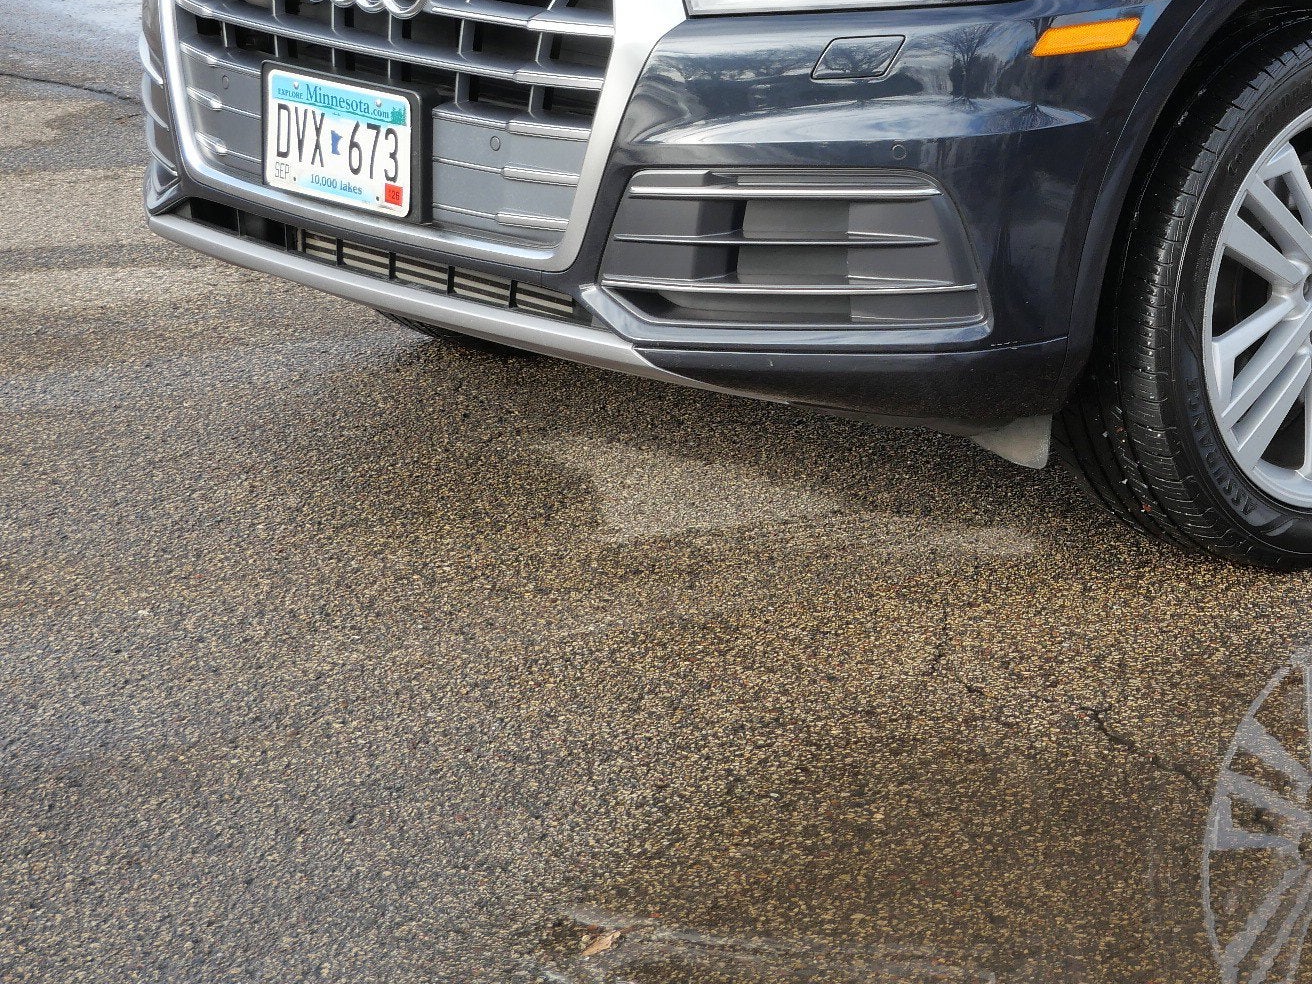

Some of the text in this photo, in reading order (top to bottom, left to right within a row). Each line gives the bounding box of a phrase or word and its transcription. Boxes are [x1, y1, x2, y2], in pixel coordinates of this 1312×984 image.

[277, 88, 304, 100] EXPLORE
[276, 103, 399, 183] DVX 673
[274, 161, 290, 179] SEP
[310, 173, 363, 195] 10,000 lakes
